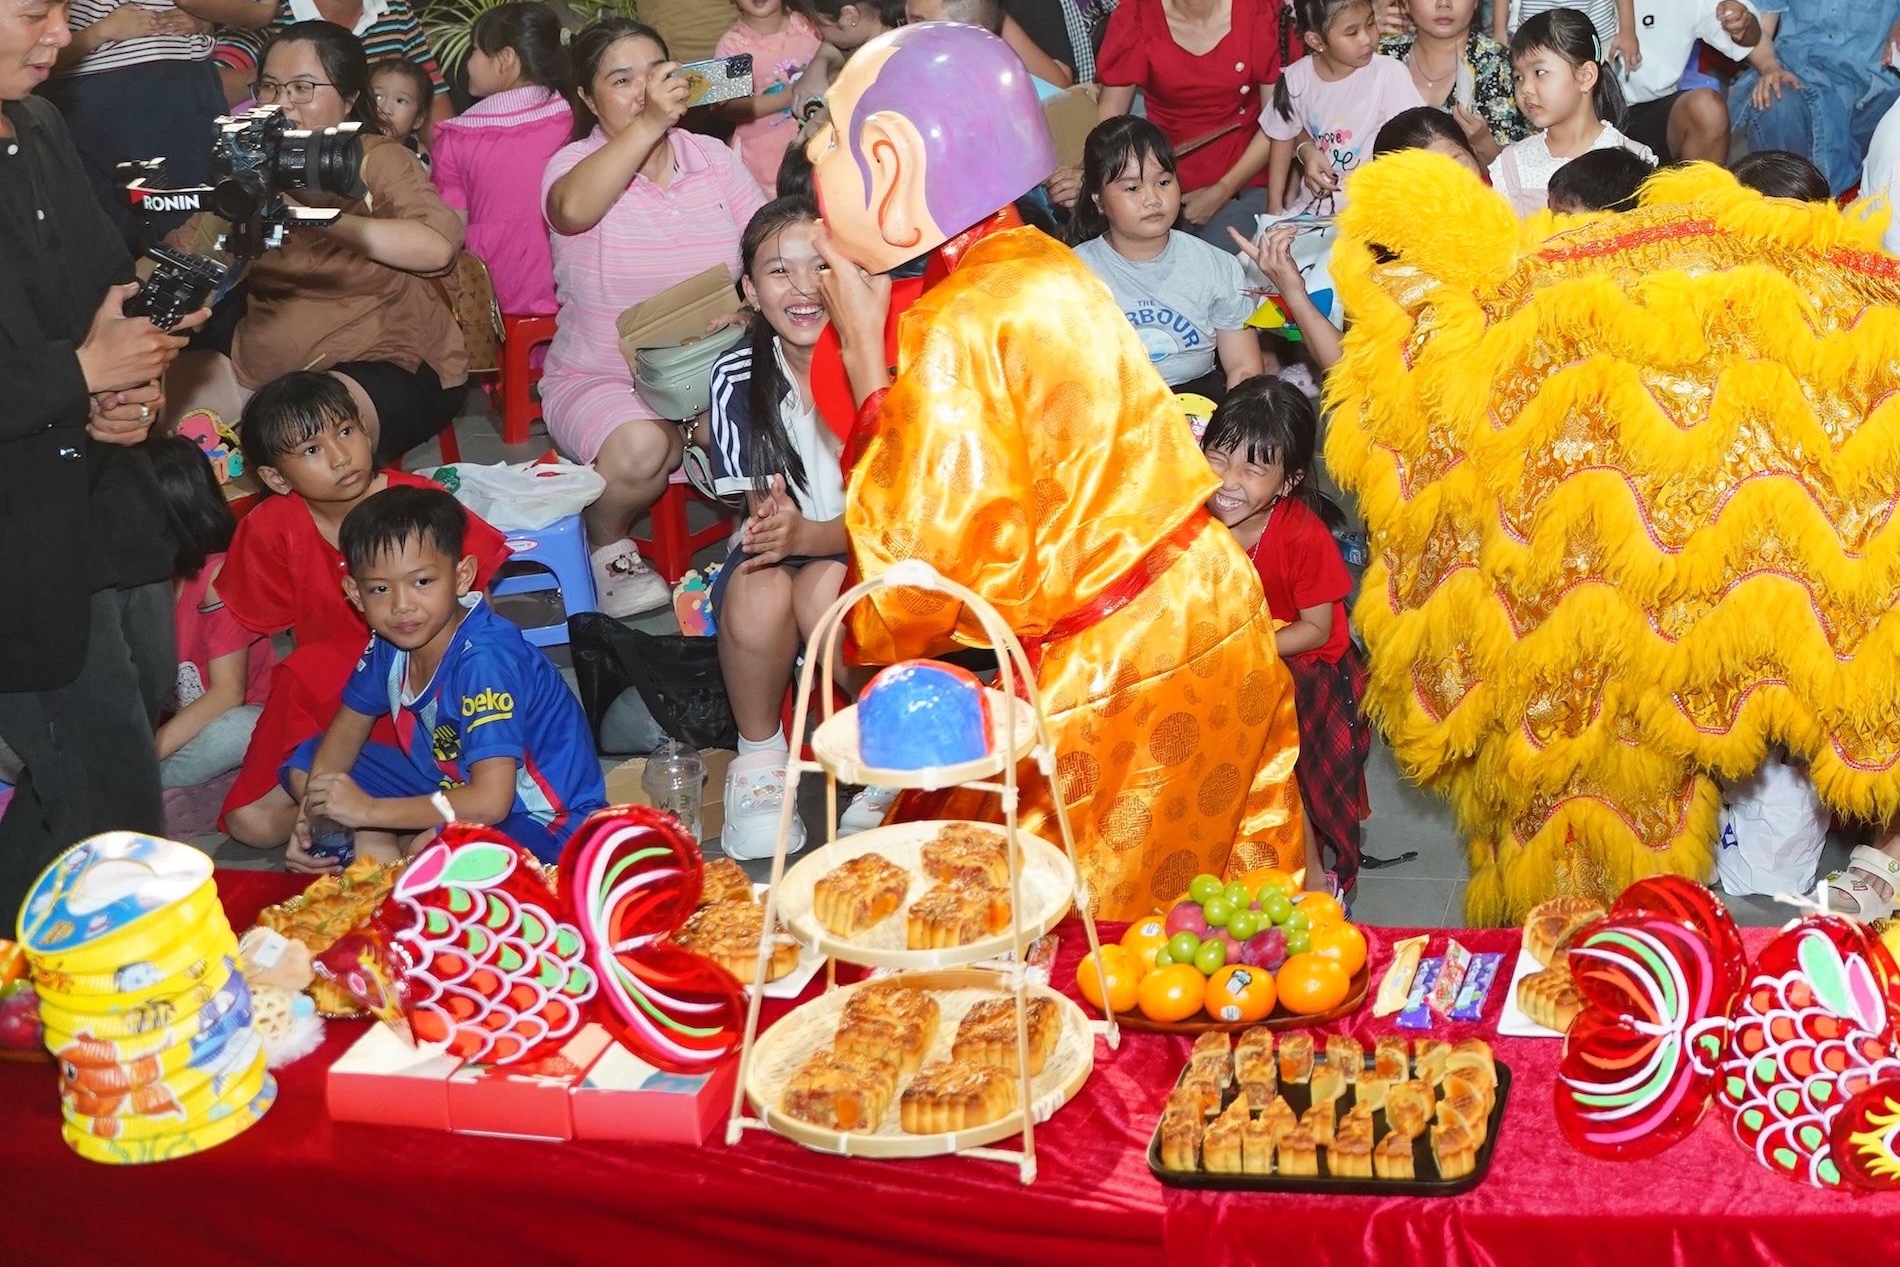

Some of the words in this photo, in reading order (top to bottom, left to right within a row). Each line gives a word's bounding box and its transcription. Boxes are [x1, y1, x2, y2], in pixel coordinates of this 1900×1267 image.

[143, 194, 201, 211] RONIN
[1137, 299, 1157, 307] THE
[461, 687, 515, 717] beko
